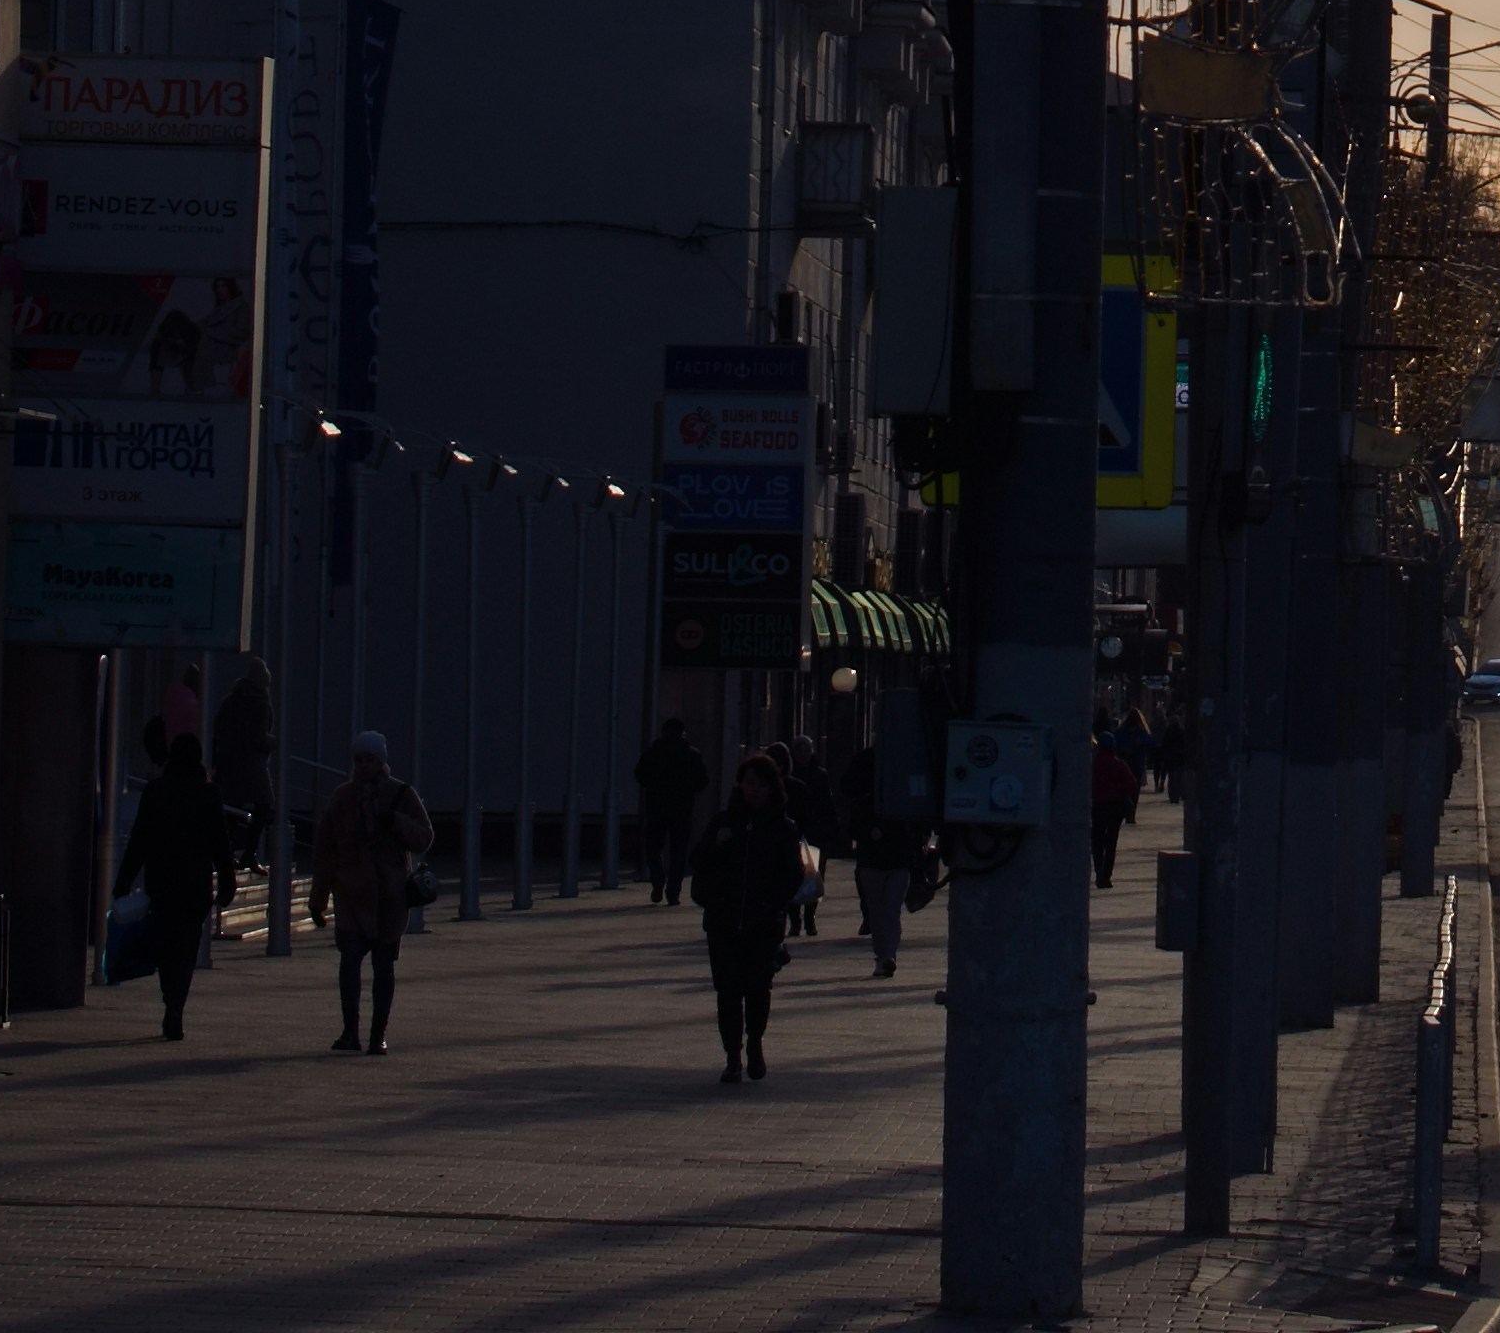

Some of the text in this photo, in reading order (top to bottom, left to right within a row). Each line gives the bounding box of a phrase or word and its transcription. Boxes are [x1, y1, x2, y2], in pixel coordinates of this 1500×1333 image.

[43, 76, 250, 119] ПАРАДИЗ
[45, 119, 247, 141] ТОРГОВЫЙ КОМПЛЕКС
[54, 194, 238, 218] RENDEZ-VOUS
[11, 295, 135, 337] Фасон
[675, 360, 732, 375] ГАСТРО
[721, 409, 799, 424] SUSHI ROLLS
[116, 417, 215, 447] ЧИТАЙ
[719, 430, 799, 450] SEAFOOD
[115, 446, 215, 478] ГОРОД
[82, 486, 143, 502] 3 этаж
[678, 473, 751, 495] PLOV
[42, 563, 175, 590] MayaKorea
[719, 613, 793, 635] OSTERIA
